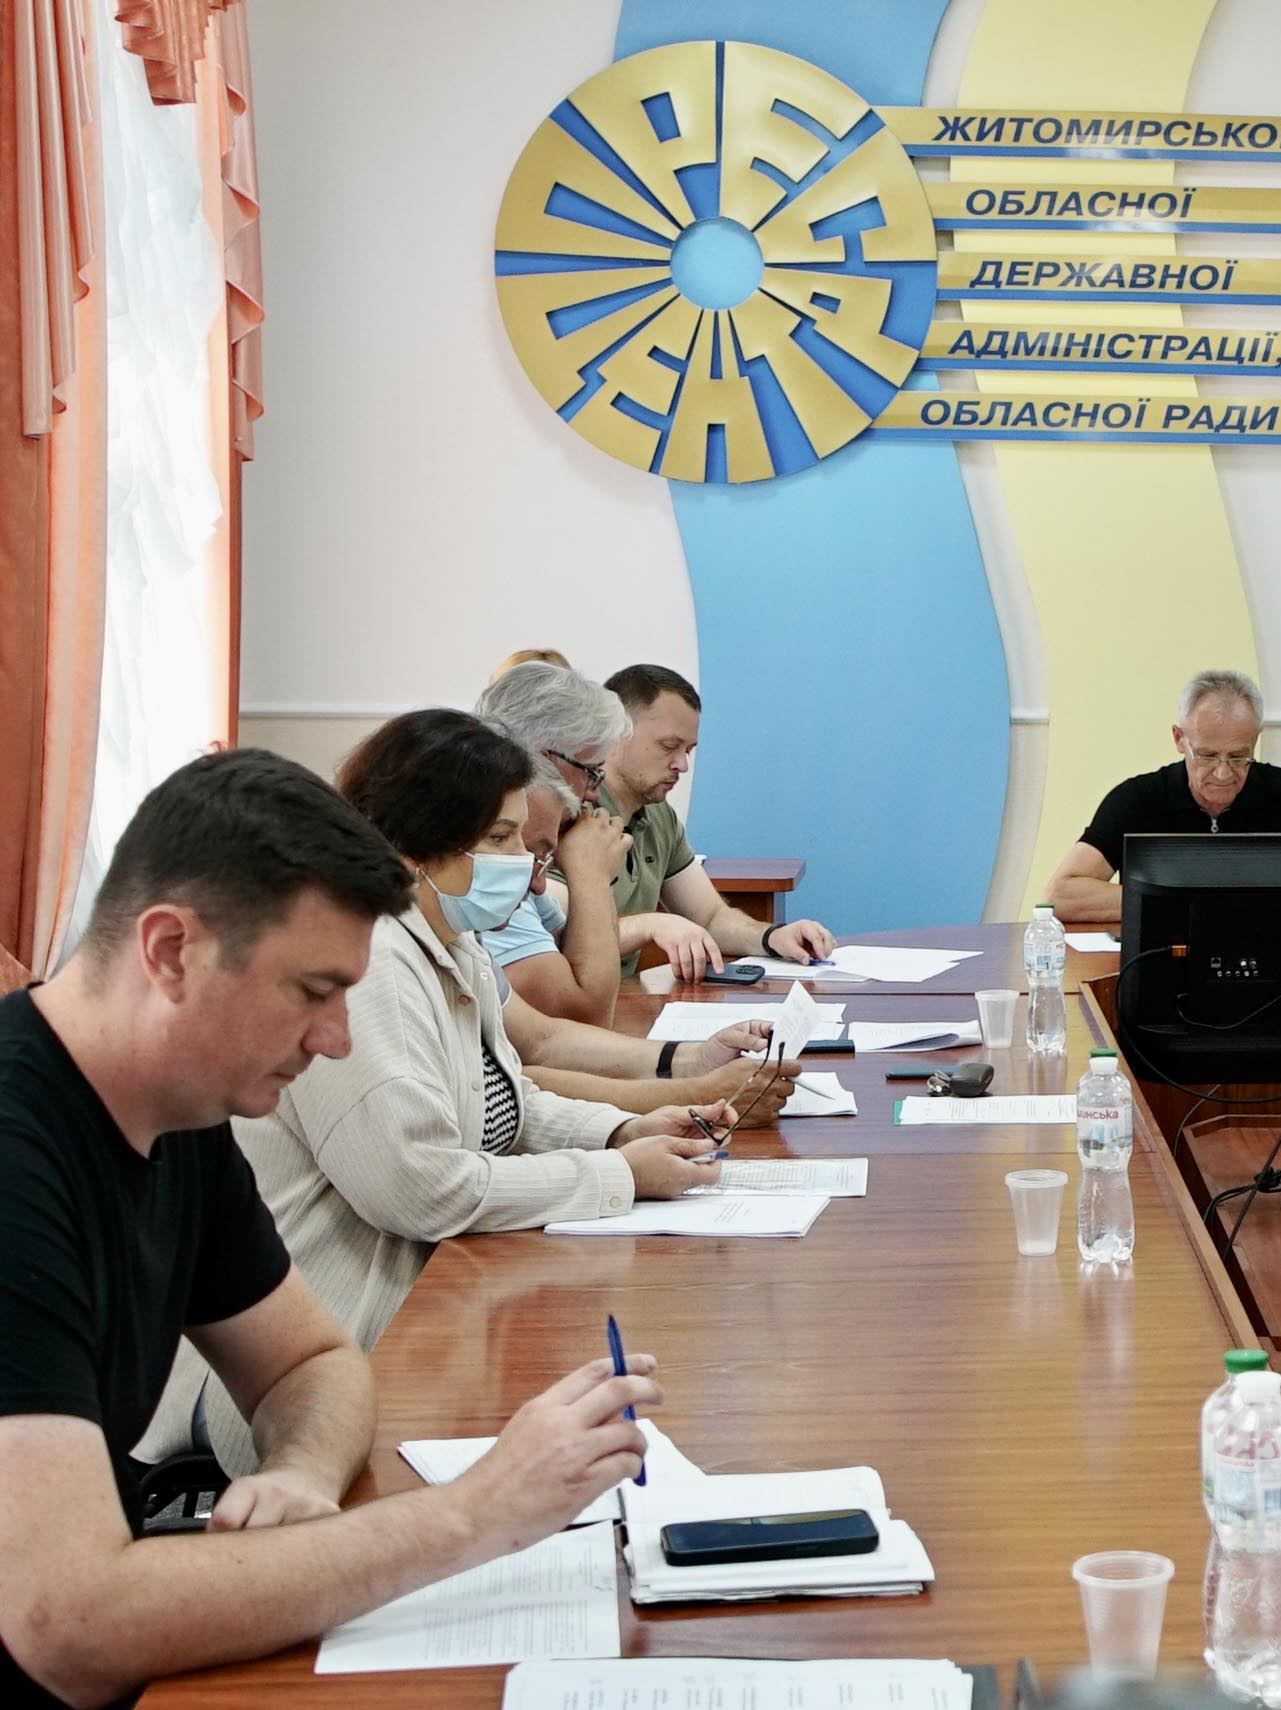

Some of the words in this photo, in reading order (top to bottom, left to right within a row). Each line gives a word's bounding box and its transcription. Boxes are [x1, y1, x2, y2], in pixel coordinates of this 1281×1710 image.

[965, 187, 1197, 218] ОБЛАСНОЇ
[969, 259, 1239, 291] ДЕРЖАВНОЇ
[919, 397, 1152, 430] ОБЛАСНОЇ
[1161, 404, 1281, 432] РАДИ
